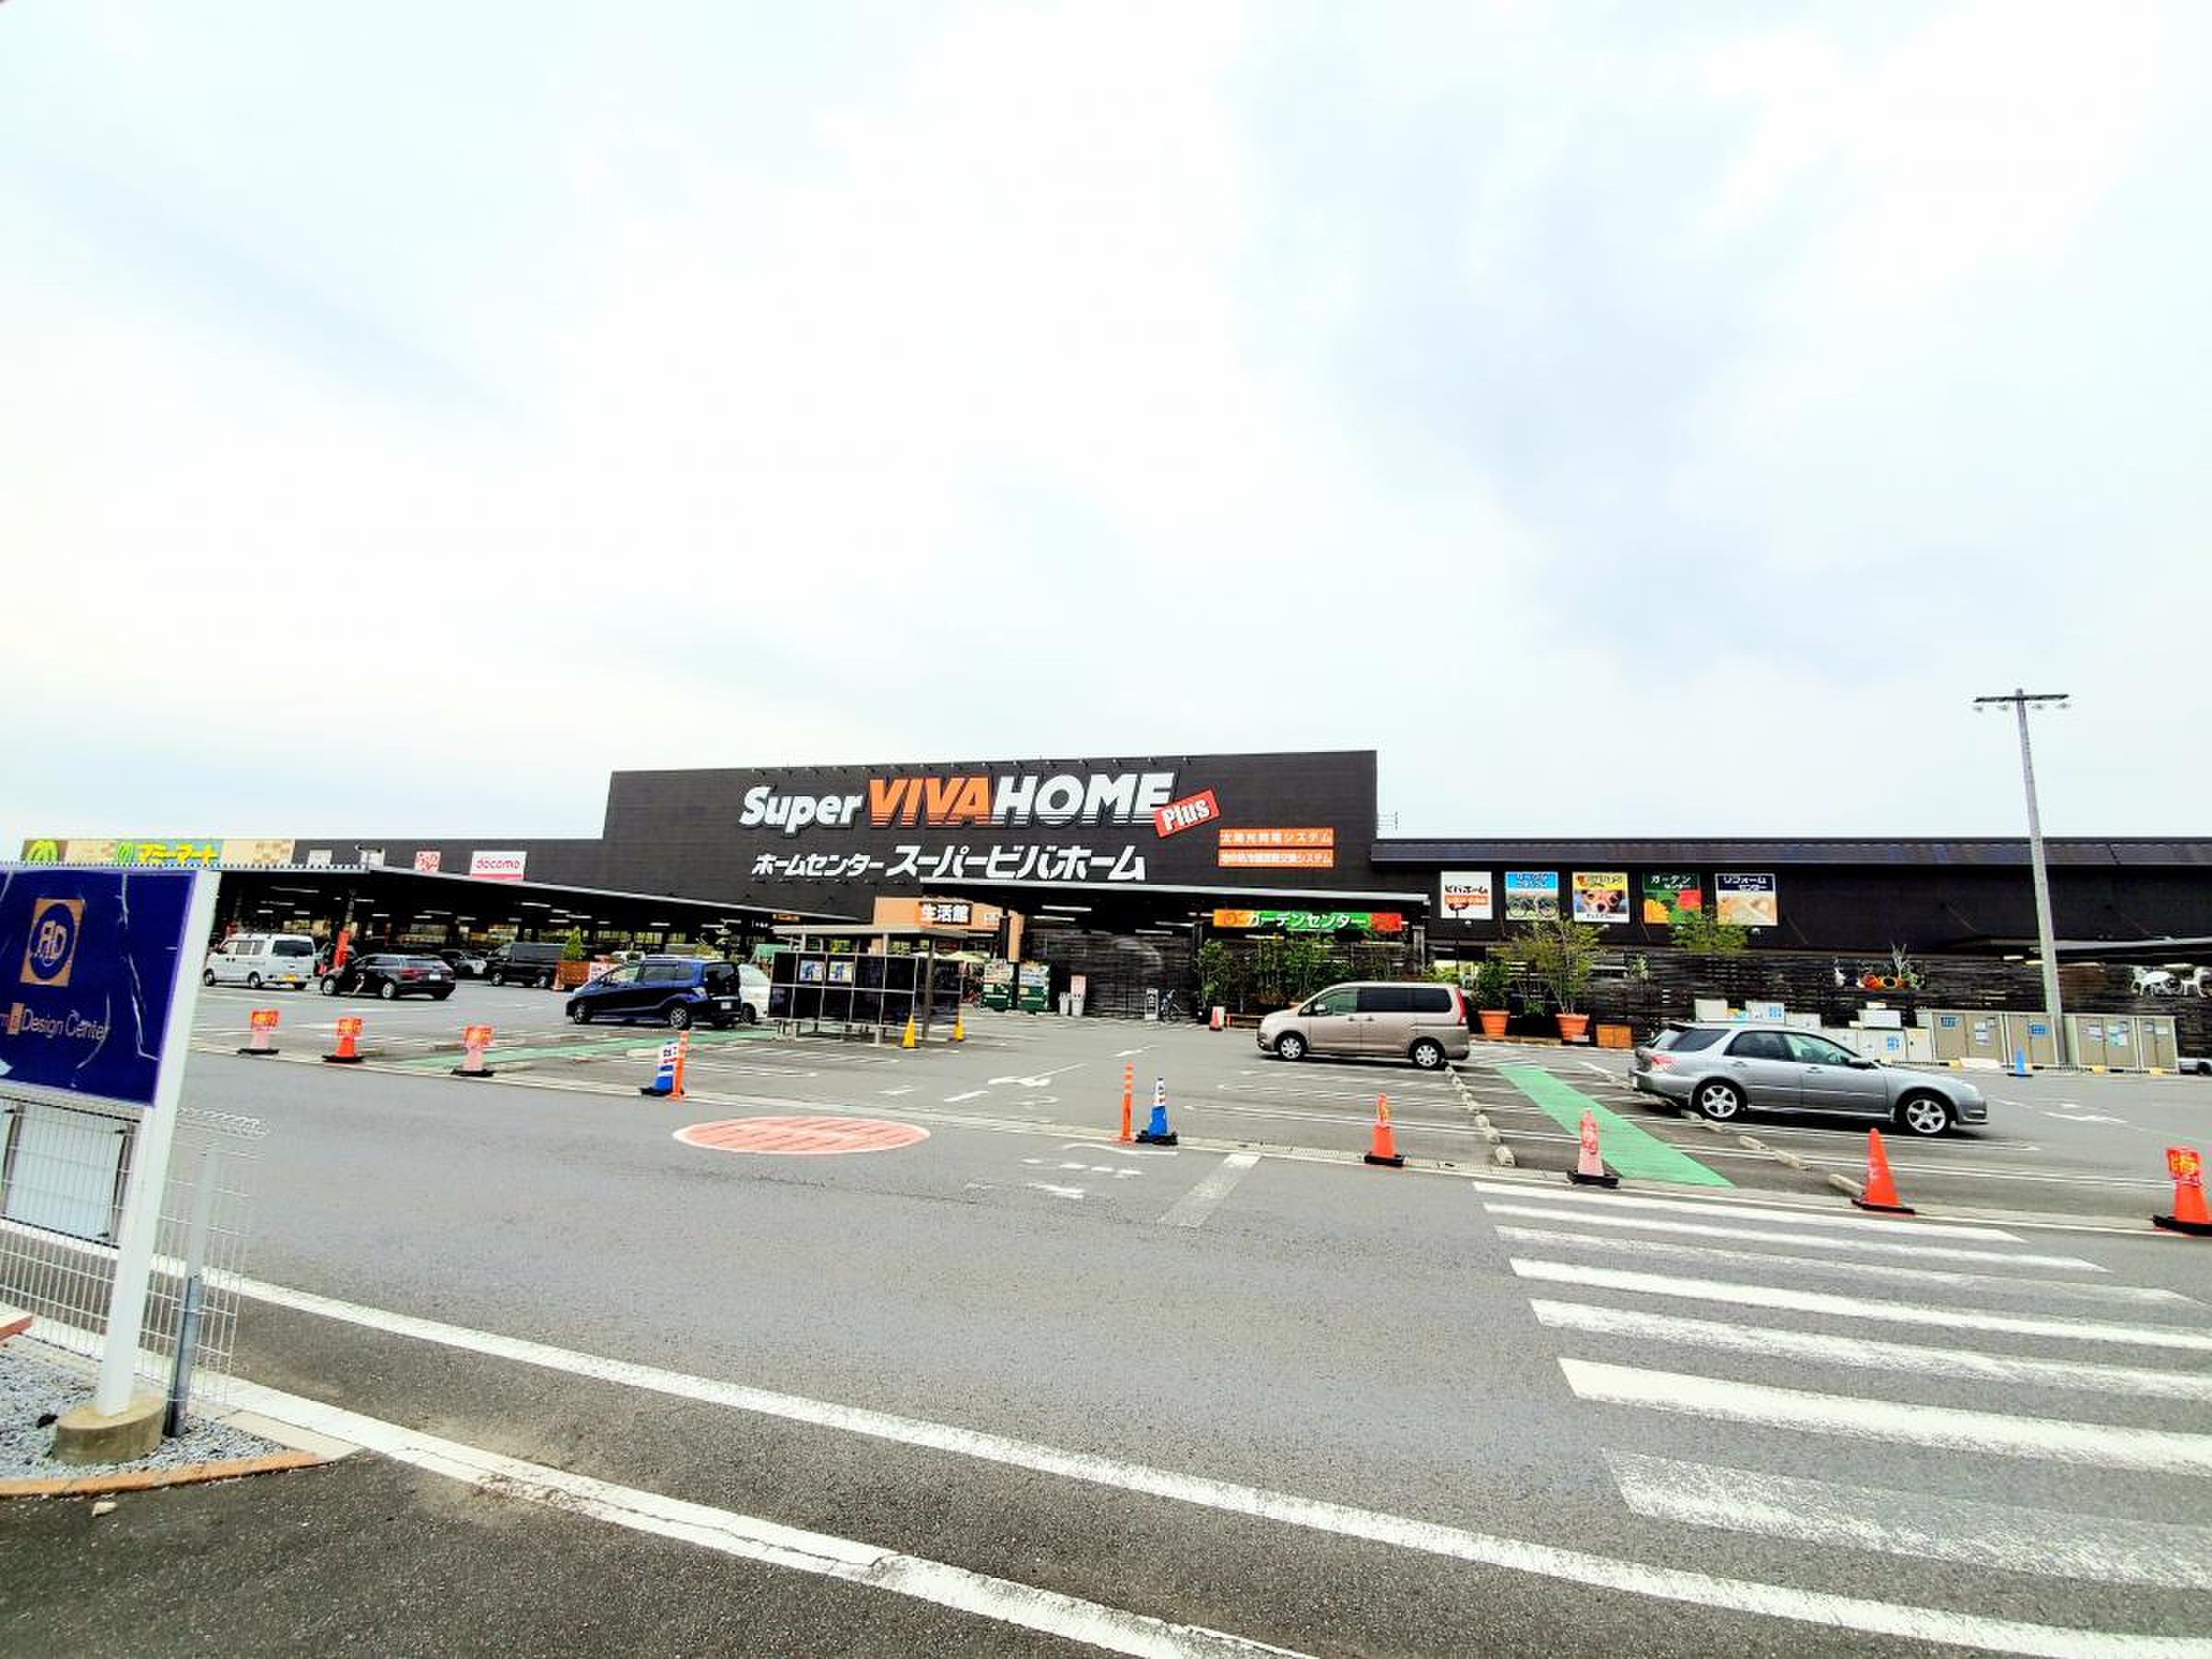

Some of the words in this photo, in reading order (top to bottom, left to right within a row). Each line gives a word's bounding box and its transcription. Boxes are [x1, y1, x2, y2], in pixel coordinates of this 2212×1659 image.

[738, 785, 864, 834] Super
[1160, 798, 1210, 831] Plus
[476, 858, 521, 870] docomo
[751, 853, 885, 877] ホームセンター
[885, 844, 1147, 881] スーパービバホーム
[920, 903, 969, 923] 生活館
[1246, 912, 1368, 928] ガーデンセンター
[21, 1008, 65, 1039] Design
[65, 1009, 109, 1041] Center
